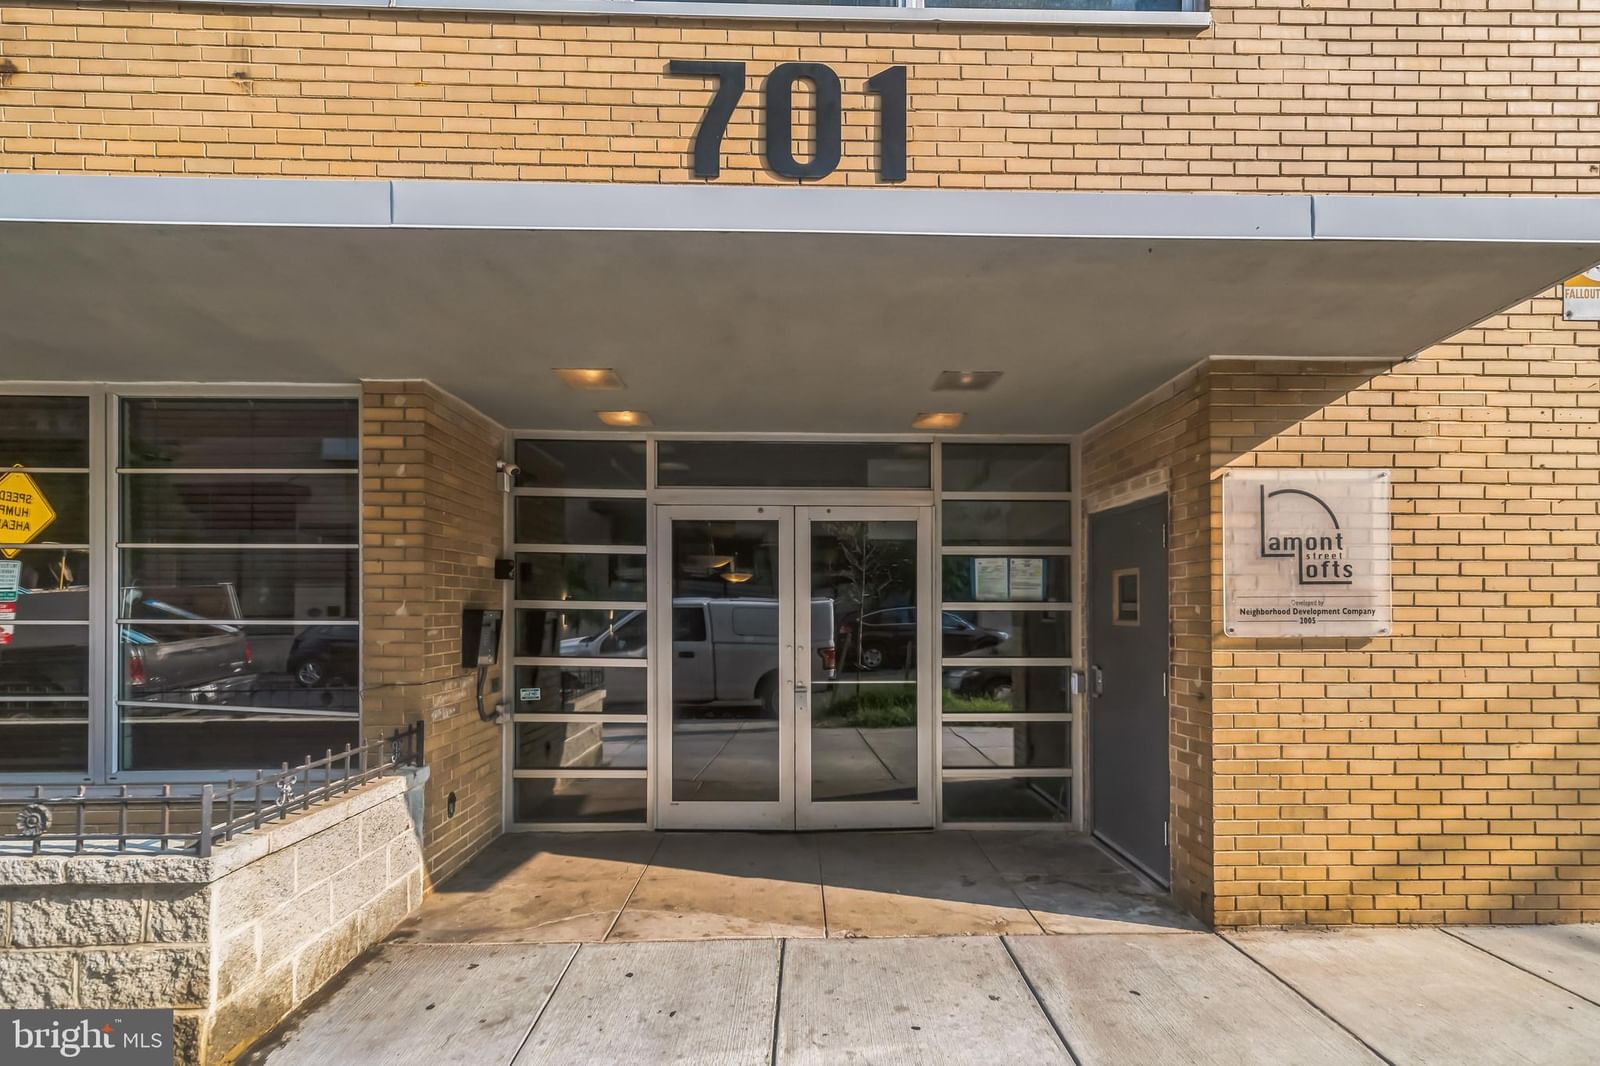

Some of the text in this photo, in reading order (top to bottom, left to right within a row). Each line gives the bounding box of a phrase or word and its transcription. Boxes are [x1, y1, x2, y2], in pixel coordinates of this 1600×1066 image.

[663, 59, 907, 182] 701
[1565, 288, 1600, 299] FALLOUT
[1260, 484, 1344, 557] Lamont
[1306, 551, 1343, 560] street
[1239, 607, 1376, 617] Neighborhood Development Company
[1299, 617, 1317, 625] 2005
